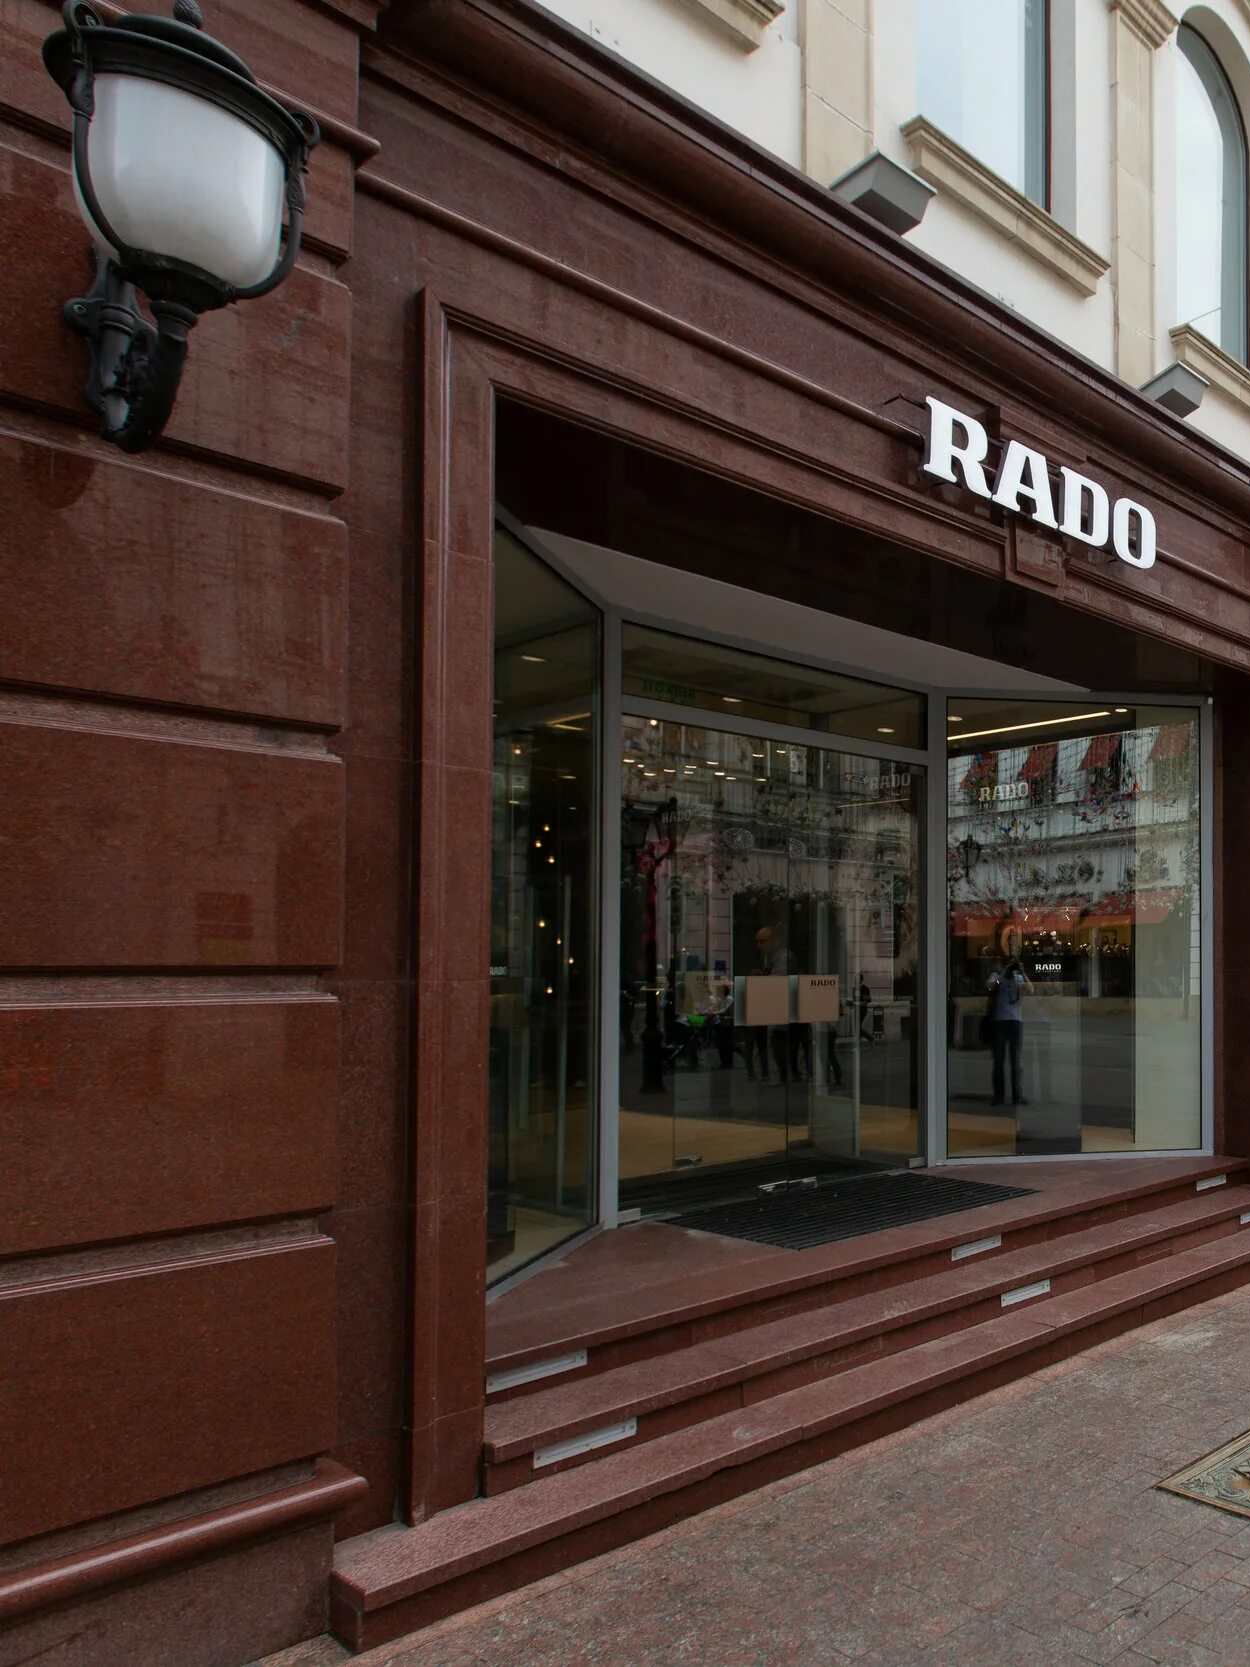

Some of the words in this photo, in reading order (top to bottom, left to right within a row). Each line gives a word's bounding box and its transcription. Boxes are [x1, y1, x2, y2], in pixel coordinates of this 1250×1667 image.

[924, 396, 1157, 570] RADO
[870, 772, 911, 790] RADO
[979, 782, 1029, 802] RADO
[1035, 963, 1062, 971] RADO
[810, 979, 836, 987] RADO
